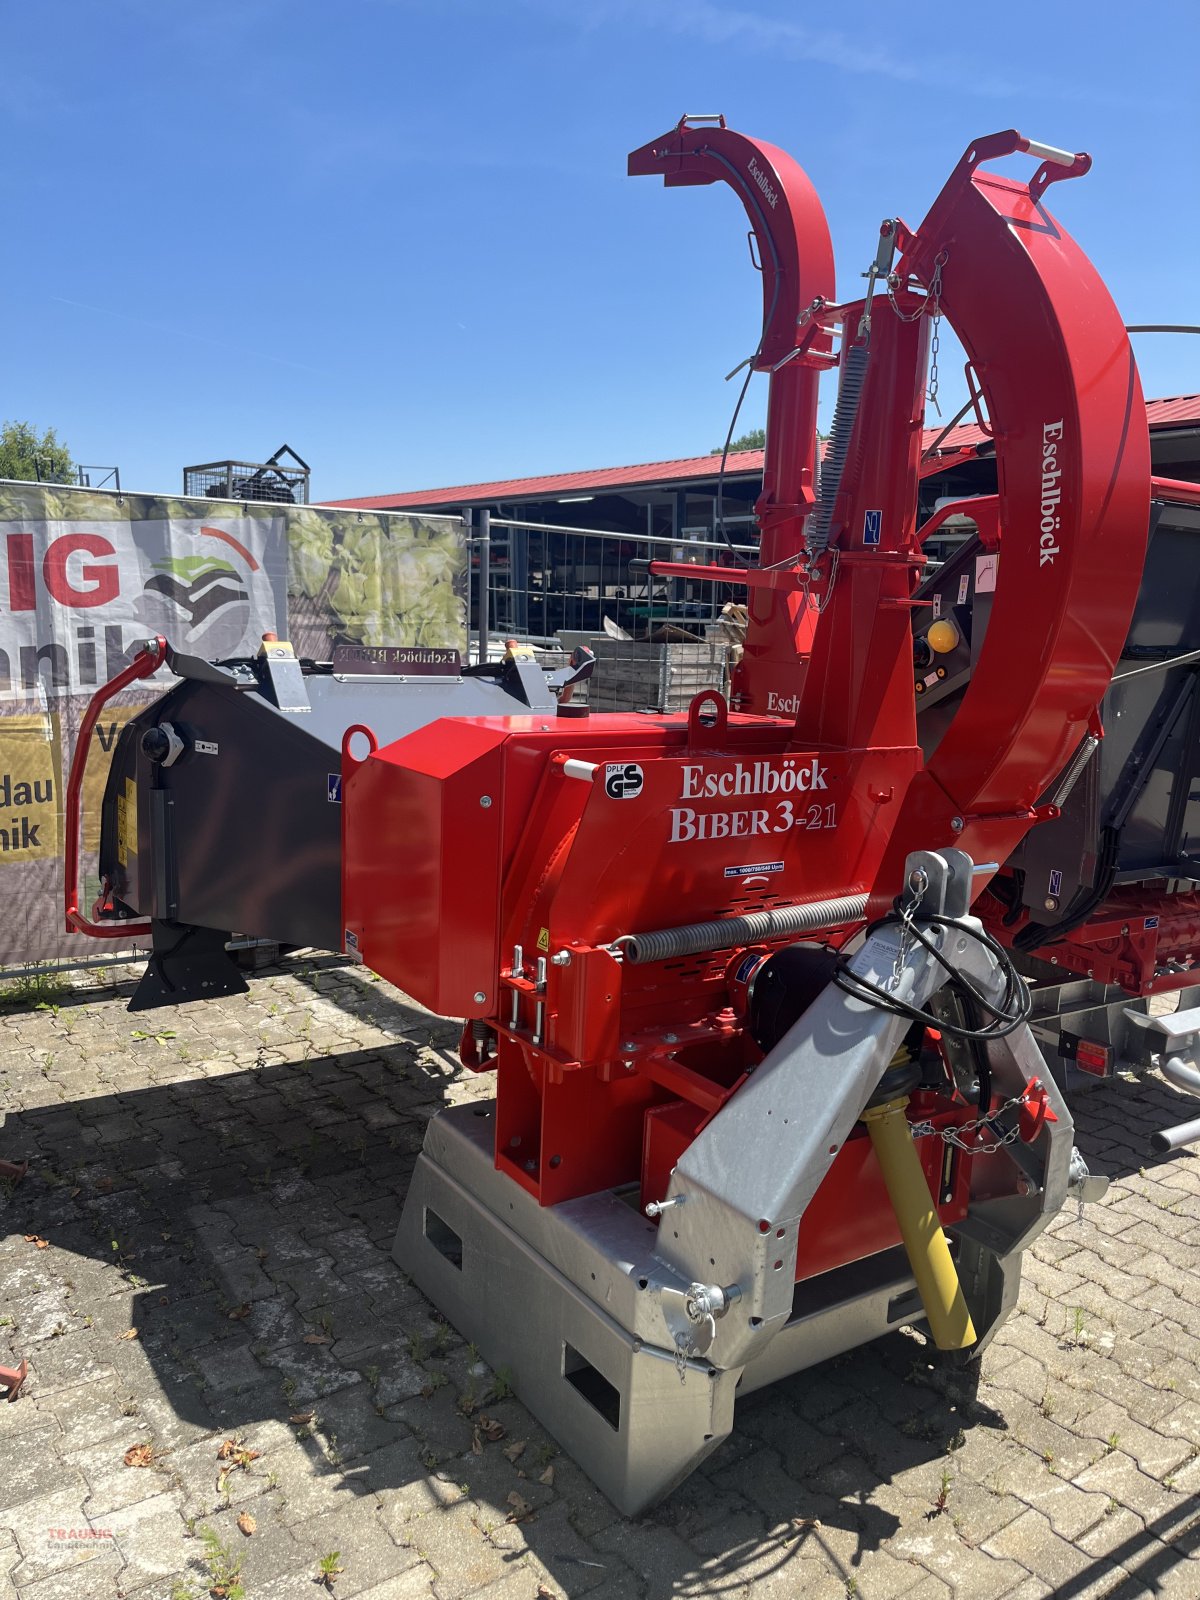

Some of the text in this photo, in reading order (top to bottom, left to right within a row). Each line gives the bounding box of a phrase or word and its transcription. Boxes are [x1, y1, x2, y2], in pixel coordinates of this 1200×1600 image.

[748, 157, 778, 209] Eschlböck
[1039, 417, 1064, 568] Eschlböck
[0, 533, 120, 611] IG
[95, 722, 122, 752] V
[680, 759, 828, 799] Eschlböck
